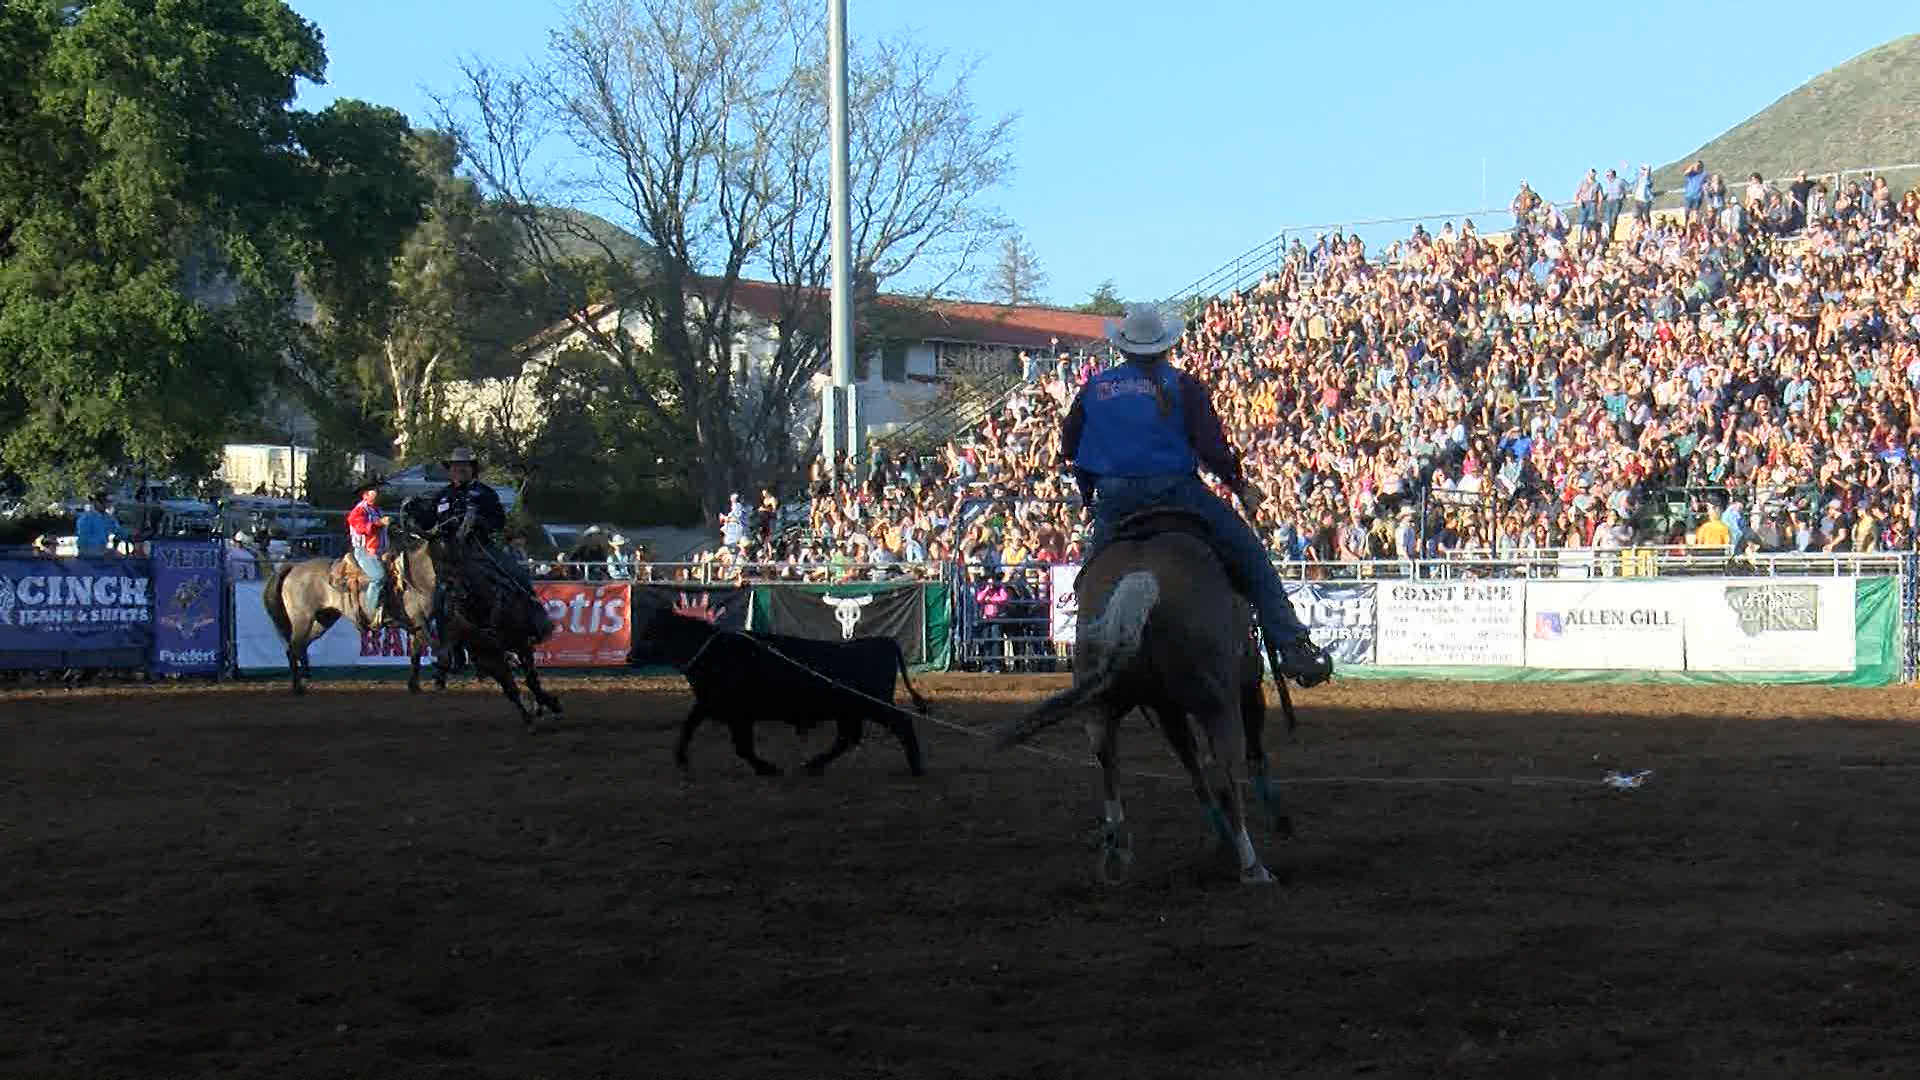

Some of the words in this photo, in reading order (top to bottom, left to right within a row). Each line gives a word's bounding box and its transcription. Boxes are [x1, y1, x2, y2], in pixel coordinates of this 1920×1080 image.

[159, 549, 217, 569] YETI
[16, 576, 149, 605] CINCH
[1392, 585, 1456, 600] COAST
[20, 609, 73, 625] JEANS
[90, 608, 149, 621] SHIRTS
[542, 585, 625, 633] etis
[1566, 609, 1624, 625] ALLEN
[1630, 609, 1676, 625] GILL
